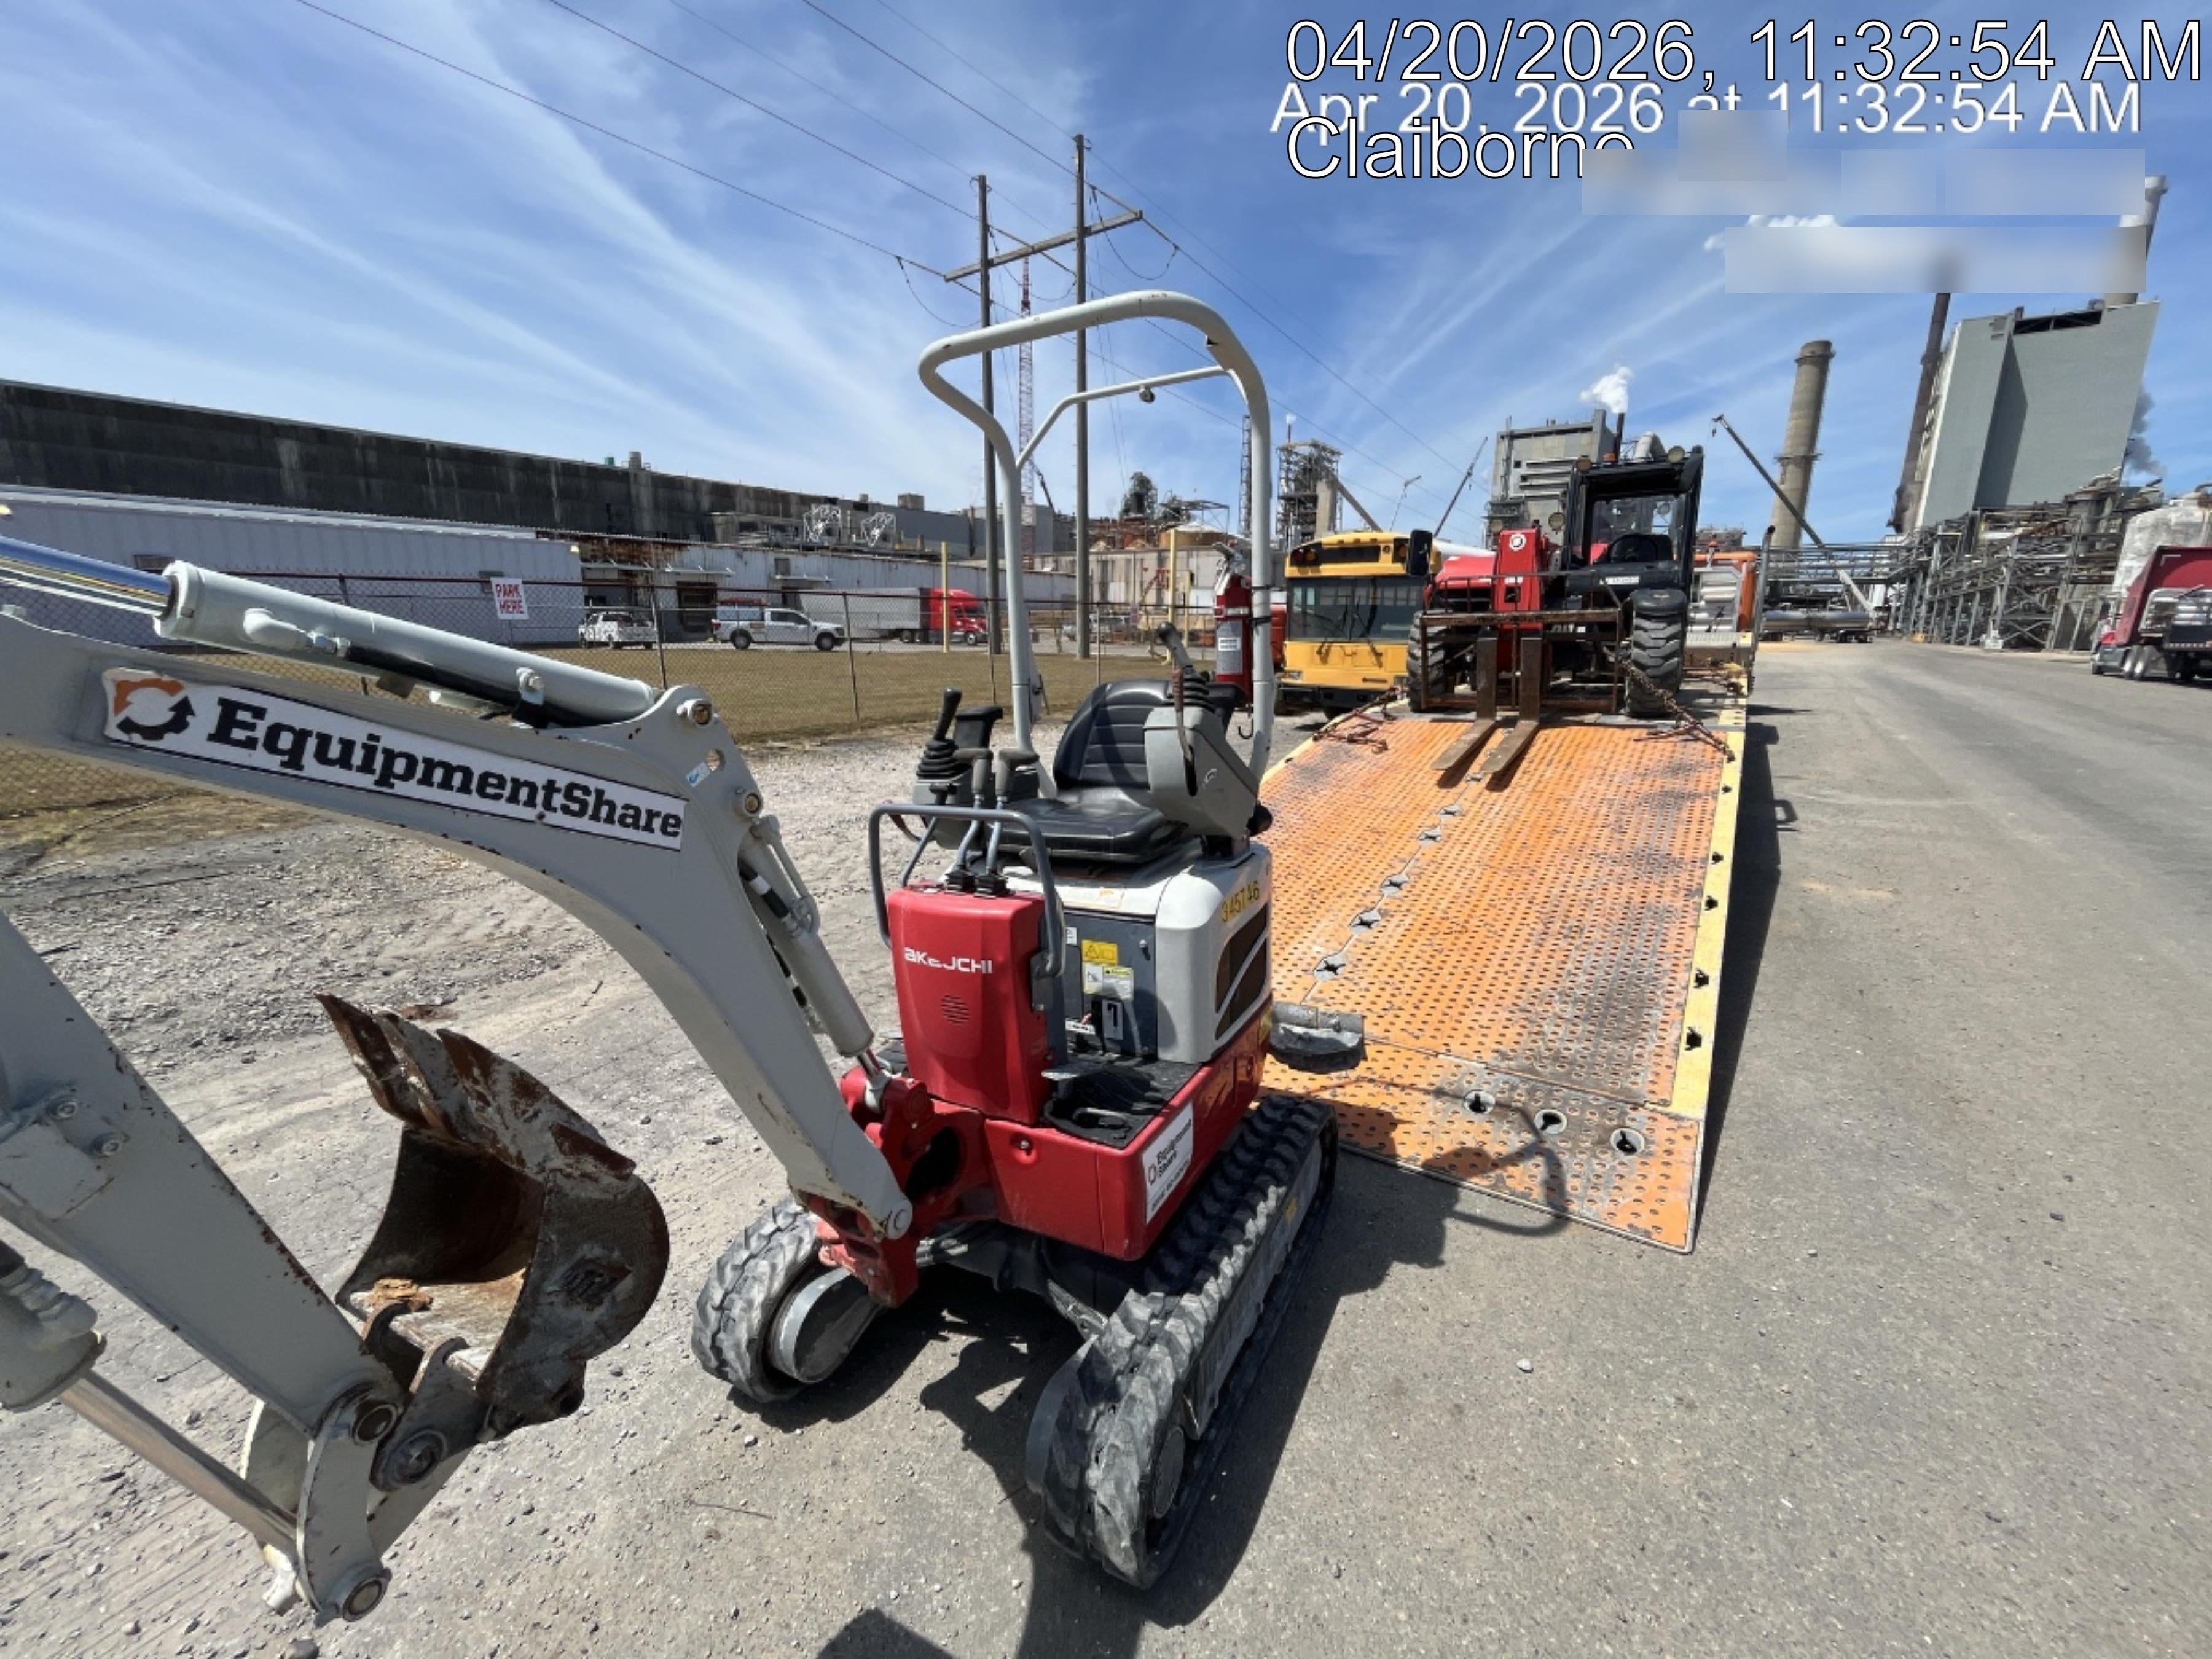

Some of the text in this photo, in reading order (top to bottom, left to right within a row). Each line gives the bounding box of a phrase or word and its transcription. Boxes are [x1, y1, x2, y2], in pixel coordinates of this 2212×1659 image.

[496, 584, 522, 597] PARK
[500, 600, 524, 614] HERE
[206, 697, 682, 837] EquipmentShare
